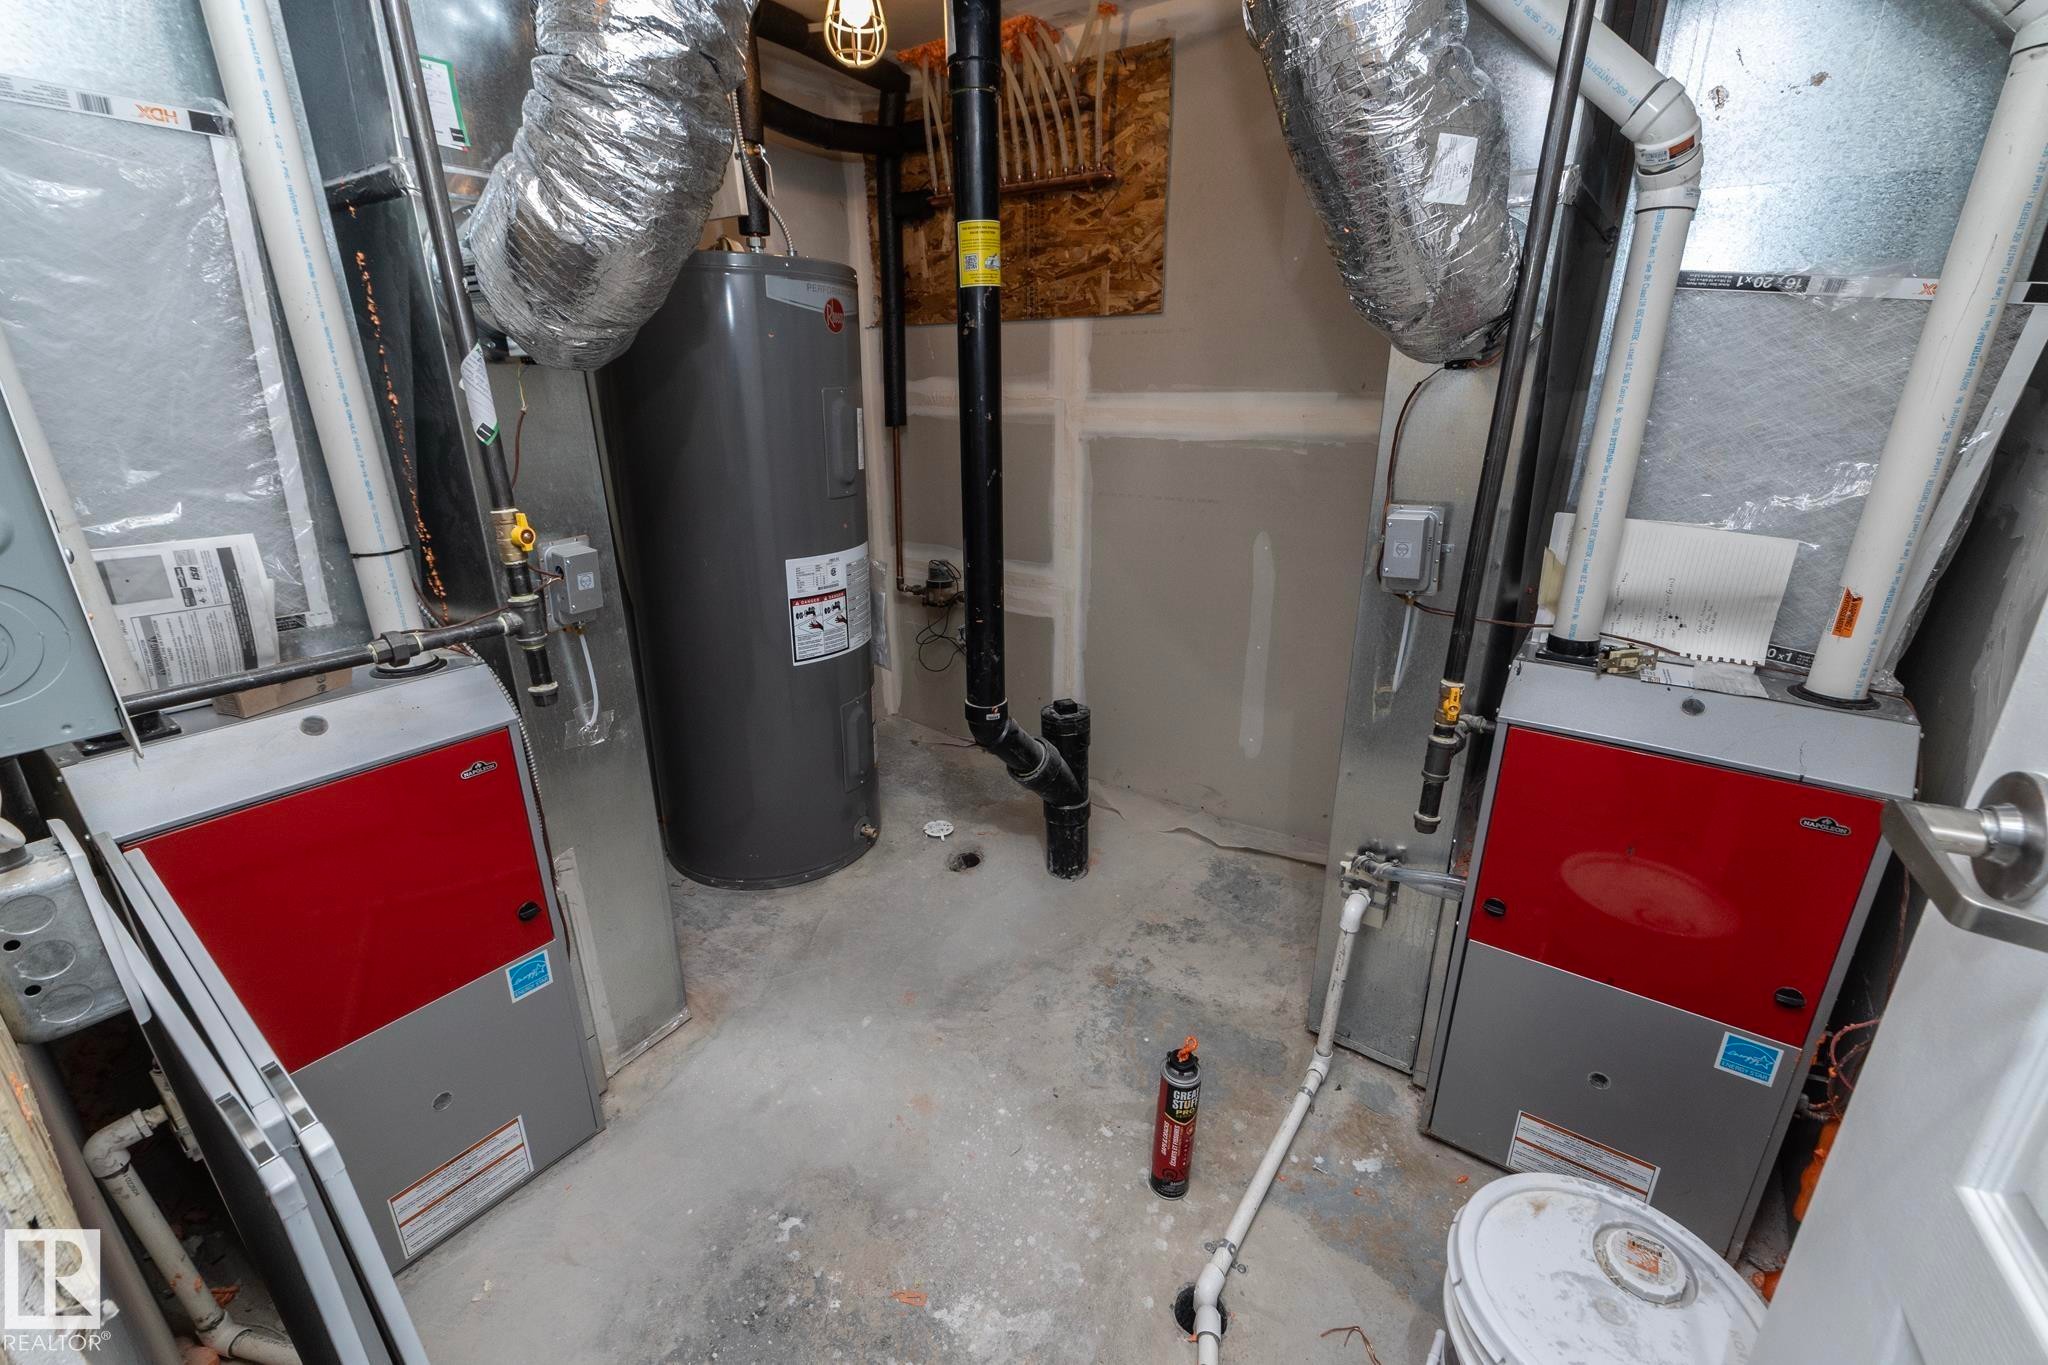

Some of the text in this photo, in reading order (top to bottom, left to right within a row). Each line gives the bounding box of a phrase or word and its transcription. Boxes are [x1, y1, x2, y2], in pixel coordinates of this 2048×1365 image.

[1582, 56, 1616, 86] INTERTE
[135, 103, 178, 124] HDX
[188, 564, 200, 581] ISO
[463, 763, 496, 778] NAPOLEON
[1803, 820, 1848, 834] NAPOLEON
[1721, 1061, 1769, 1081] ENERGY STAR
[1173, 1088, 1199, 1101] GREAT
[1172, 1099, 1198, 1110] STUFF
[1161, 1121, 1169, 1139] CRACKS
[1159, 1143, 1167, 1155] GAPS
